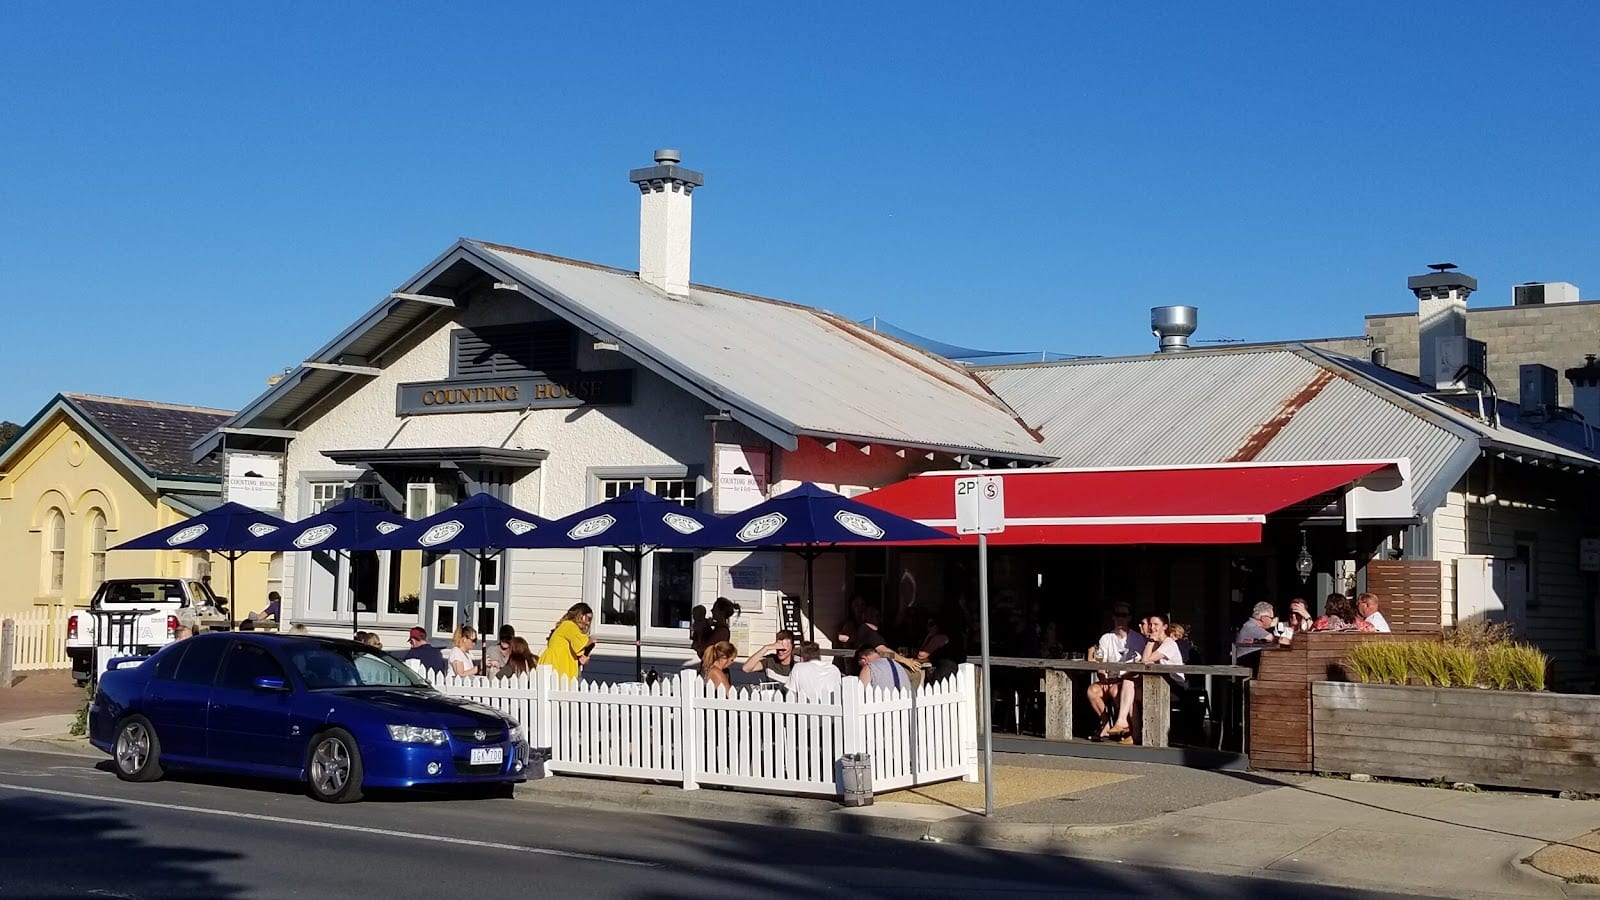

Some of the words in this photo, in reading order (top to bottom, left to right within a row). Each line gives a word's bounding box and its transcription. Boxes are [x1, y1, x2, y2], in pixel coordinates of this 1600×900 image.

[423, 385, 519, 406] COUNTING
[535, 381, 602, 400] HOUSE
[958, 481, 976, 495] 2P
